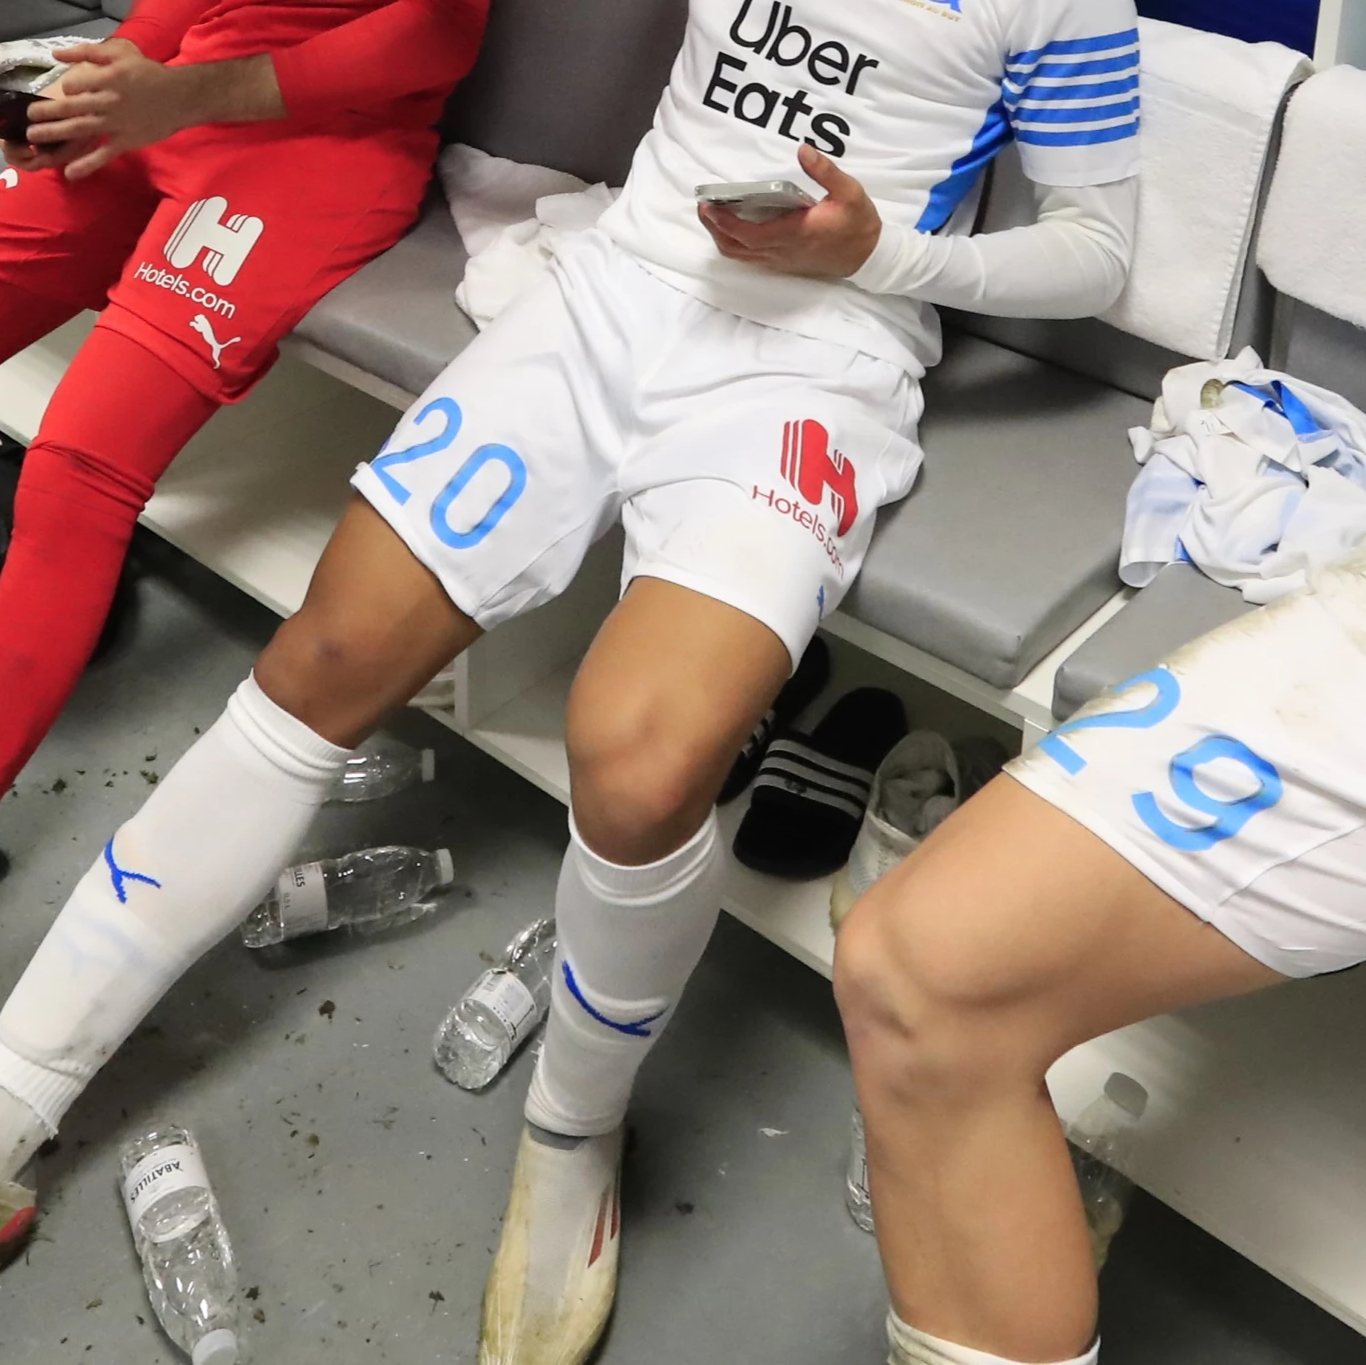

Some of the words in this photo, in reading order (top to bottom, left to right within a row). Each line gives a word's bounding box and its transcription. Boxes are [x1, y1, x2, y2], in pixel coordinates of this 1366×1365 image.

[701, 51, 852, 160] Eats
[134, 261, 237, 320] Hotels.com
[370, 396, 528, 551] 20
[752, 484, 845, 581] Hotels.com
[1035, 666, 1284, 852] 29
